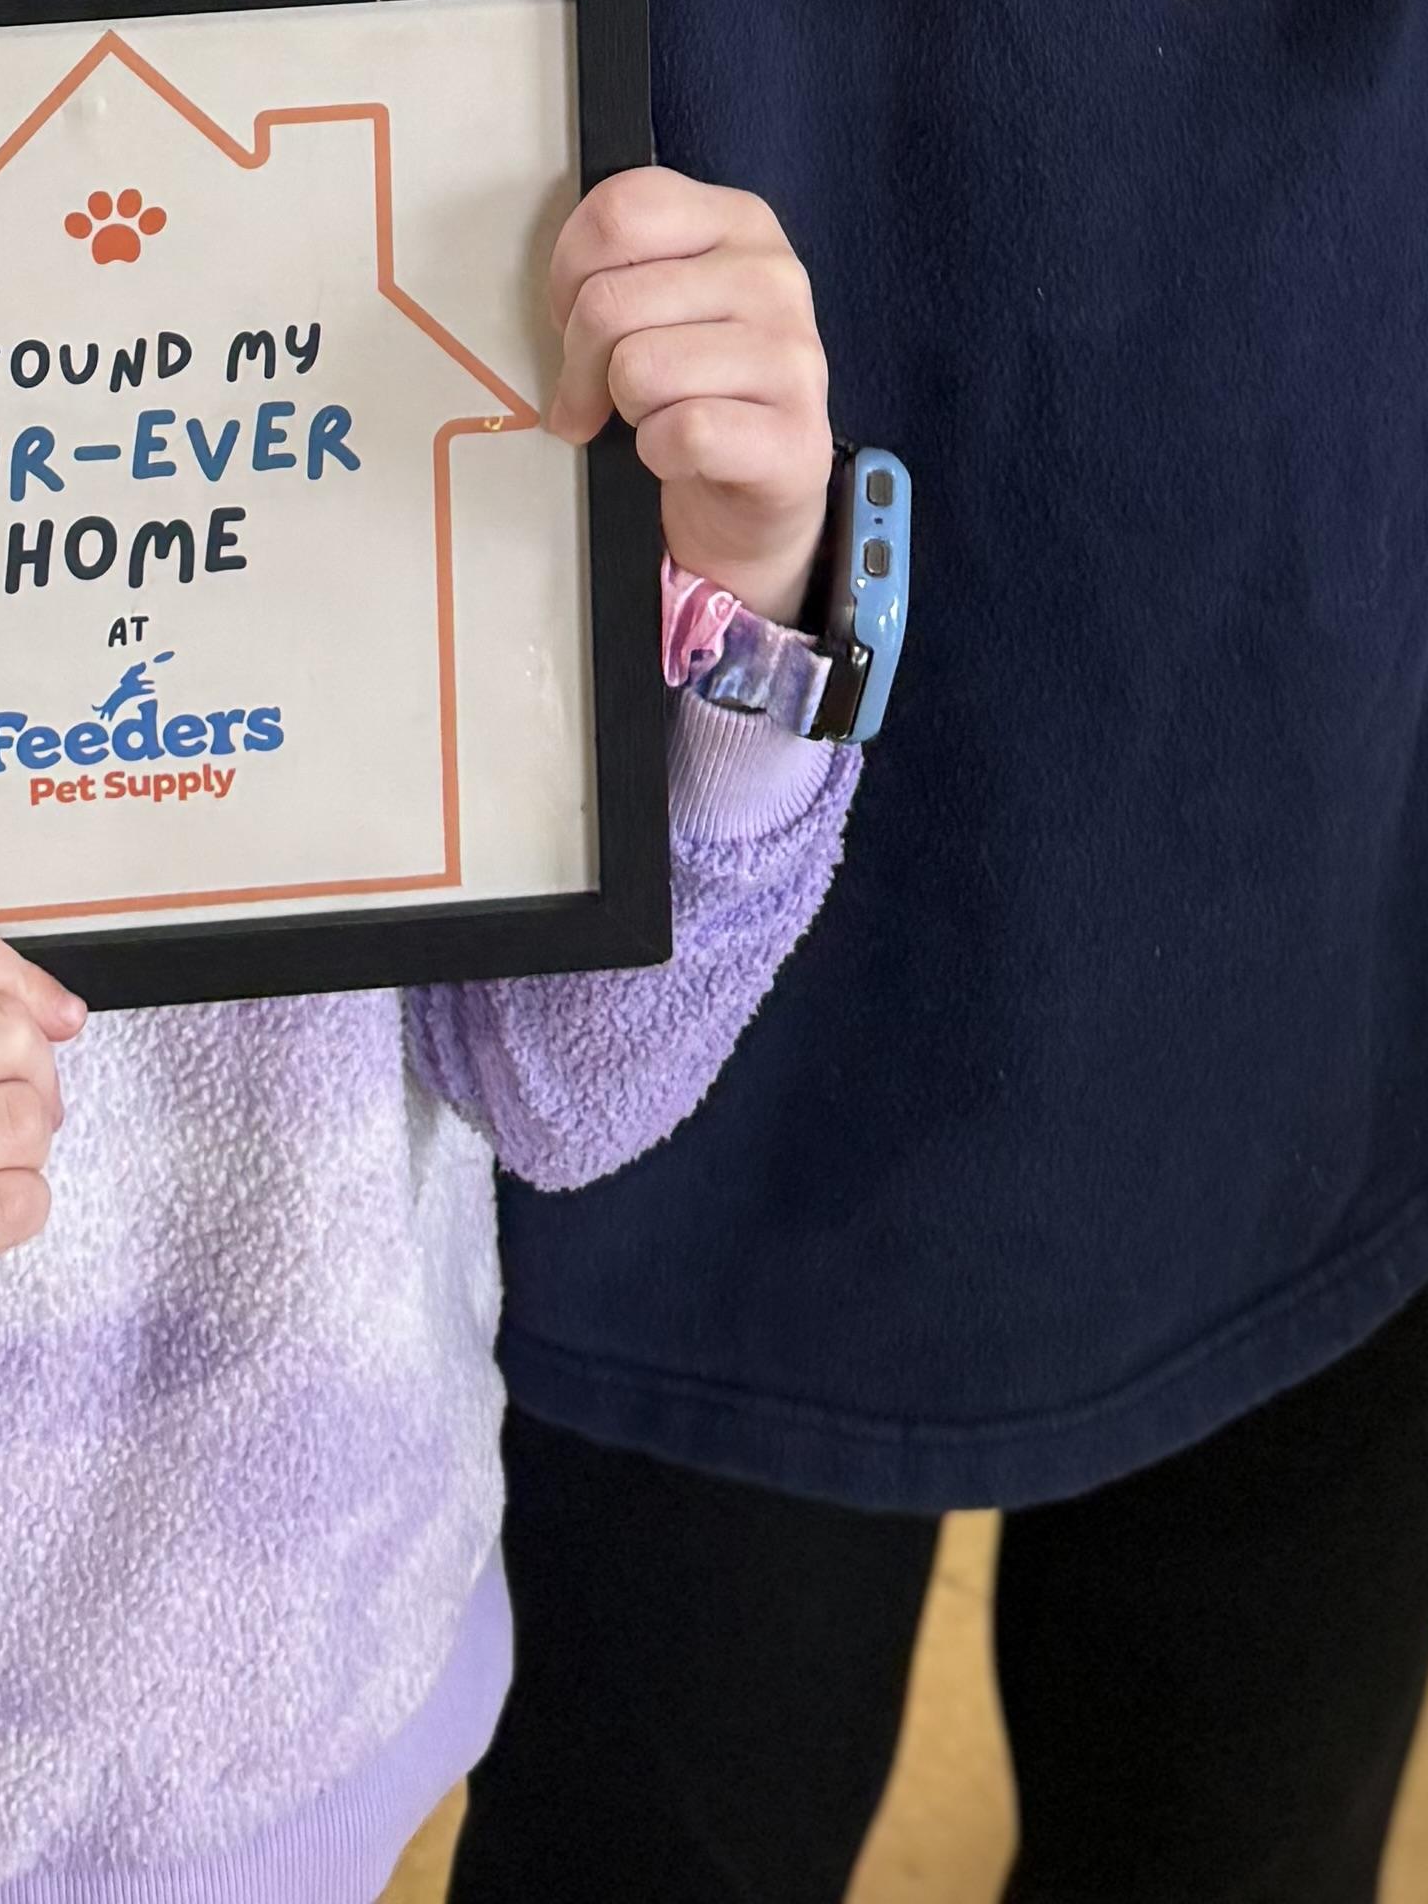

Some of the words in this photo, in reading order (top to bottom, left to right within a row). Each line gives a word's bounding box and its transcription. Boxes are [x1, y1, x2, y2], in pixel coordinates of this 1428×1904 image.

[225, 322, 322, 383] MY
[4, 506, 248, 595] HOME
[106, 615, 151, 648] AT
[29, 771, 98, 806] Pet
[103, 763, 236, 802] Supply
